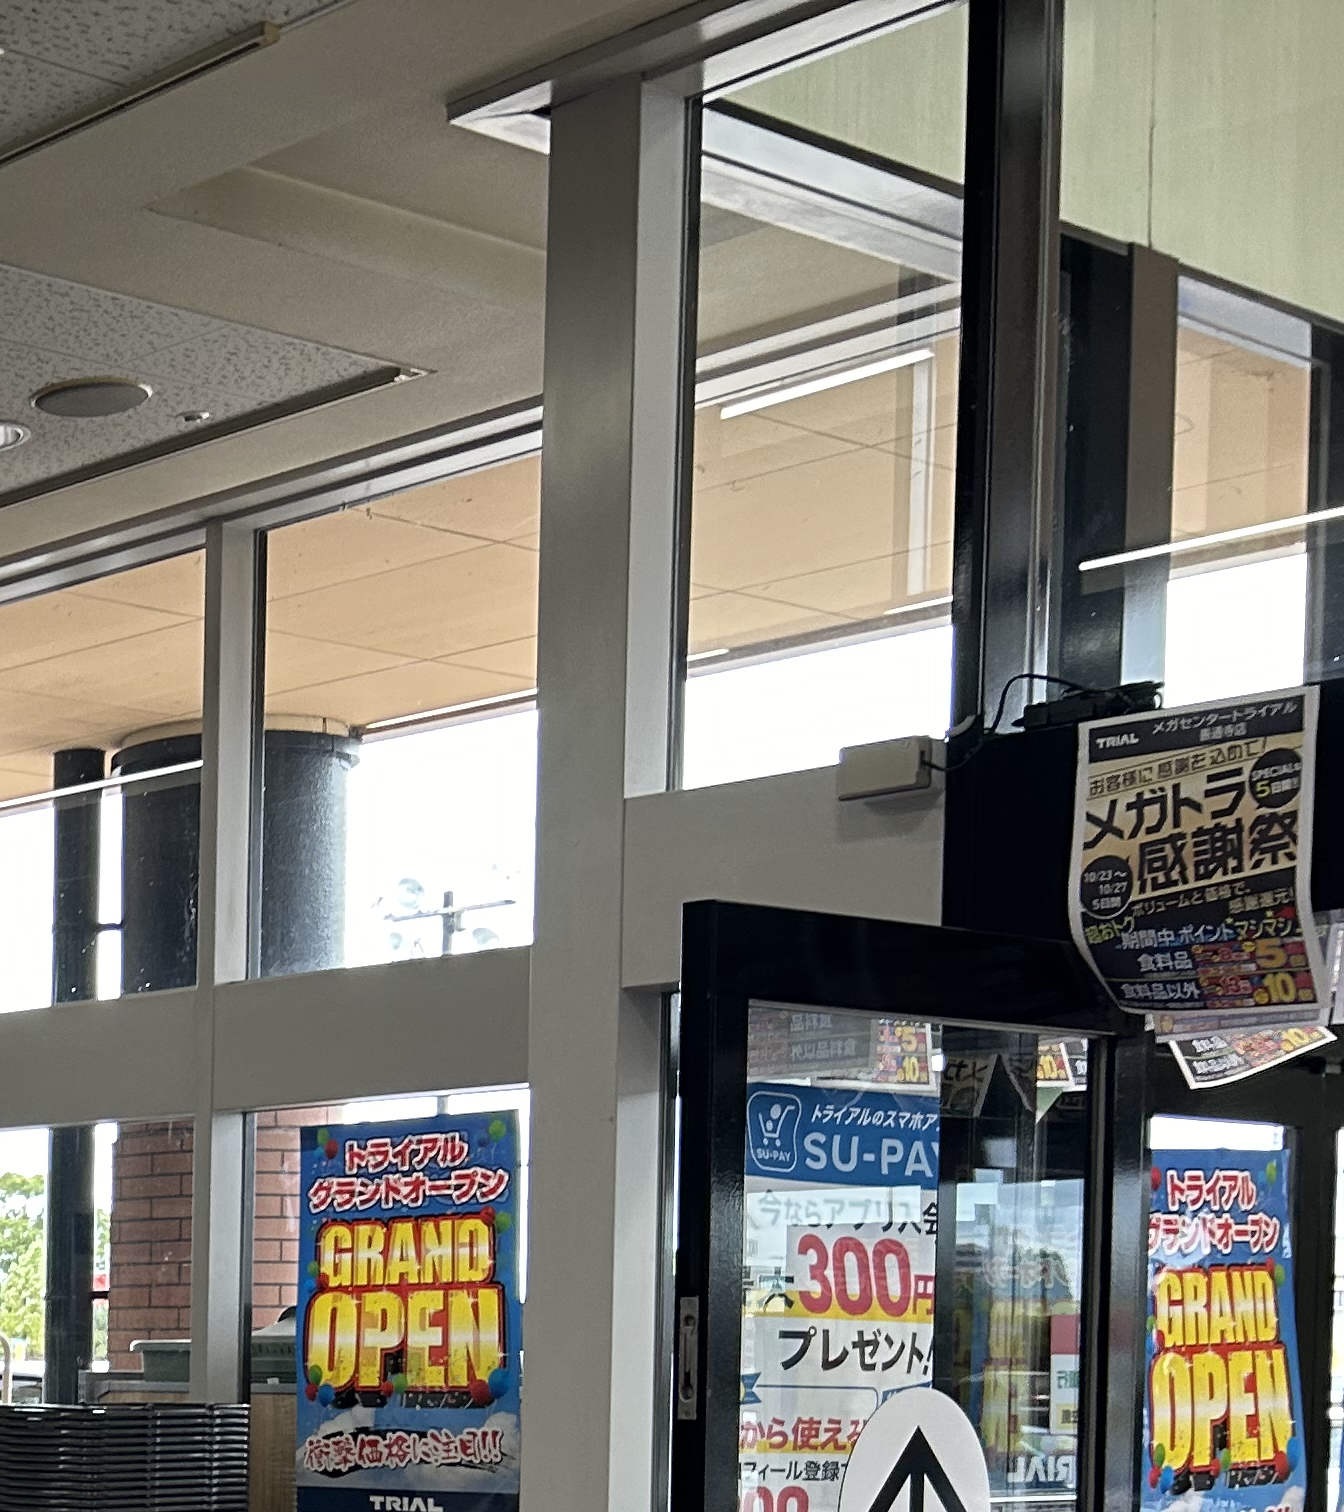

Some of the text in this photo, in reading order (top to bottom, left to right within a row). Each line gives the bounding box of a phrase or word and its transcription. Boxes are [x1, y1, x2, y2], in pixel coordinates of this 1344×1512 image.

[1152, 701, 1298, 735] メガセンタートライアル
[1096, 733, 1139, 749] TRIAL
[1083, 767, 1246, 850] メガトラ
[1139, 809, 1299, 894] 感謝祭
[1178, 923, 1235, 944] ポイント
[1137, 951, 1193, 973] 食料品
[1255, 938, 1287, 968] 5
[1120, 982, 1200, 1000] 食料品以外
[1263, 973, 1296, 1002] 10
[811, 1103, 940, 1132] トライアルのスマホア
[344, 1133, 468, 1172] トライアル
[756, 1148, 792, 1162] SU-PAY
[308, 1167, 510, 1214] グランドオープン
[1166, 1169, 1256, 1212] トライアル
[319, 1217, 495, 1286] GRAND
[1155, 1269, 1278, 1349] GRAND
[308, 1286, 504, 1391] OPEN
[1152, 1349, 1292, 1473] OPEN
[305, 1427, 503, 1472] 衝撃価格に注目!!
[369, 1495, 444, 1512] TRIAL
